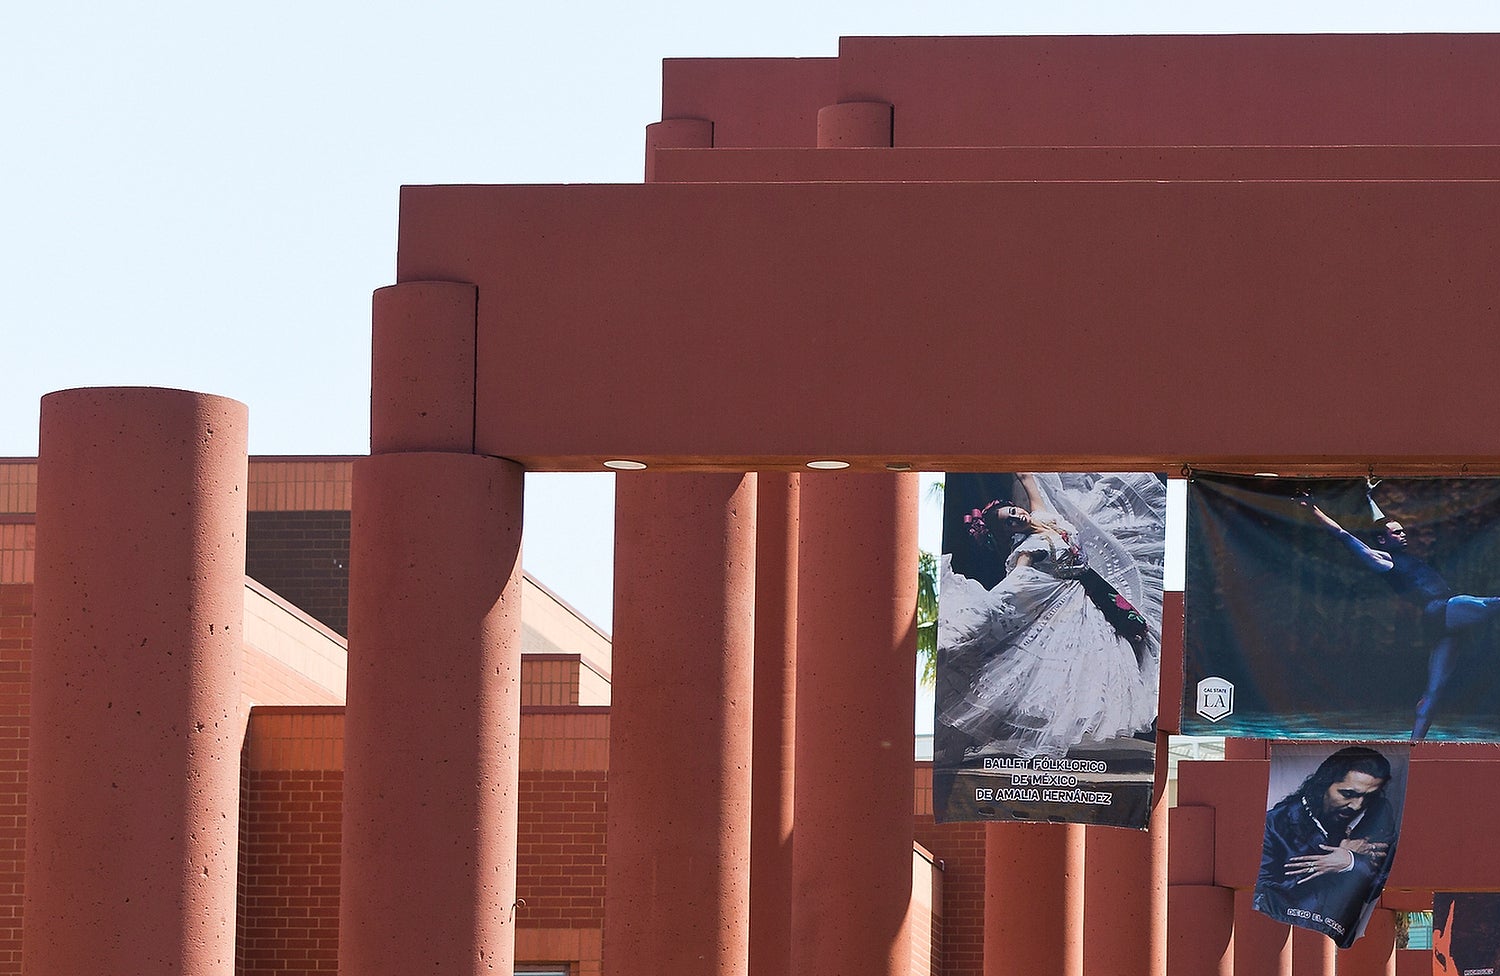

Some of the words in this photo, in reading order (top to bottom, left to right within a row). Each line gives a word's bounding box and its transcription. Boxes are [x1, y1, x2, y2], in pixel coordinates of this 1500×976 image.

[1203, 694, 1226, 708] LA
[983, 757, 1031, 771] BALLET
[1032, 756, 1108, 773] FÓLKLORICO
[1011, 773, 1029, 786] DE
[1031, 772, 1079, 788] MÉXICO
[975, 788, 993, 802] DE
[995, 788, 1041, 802] AMALIA
[1043, 787, 1113, 806] HERNÁNDEZ
